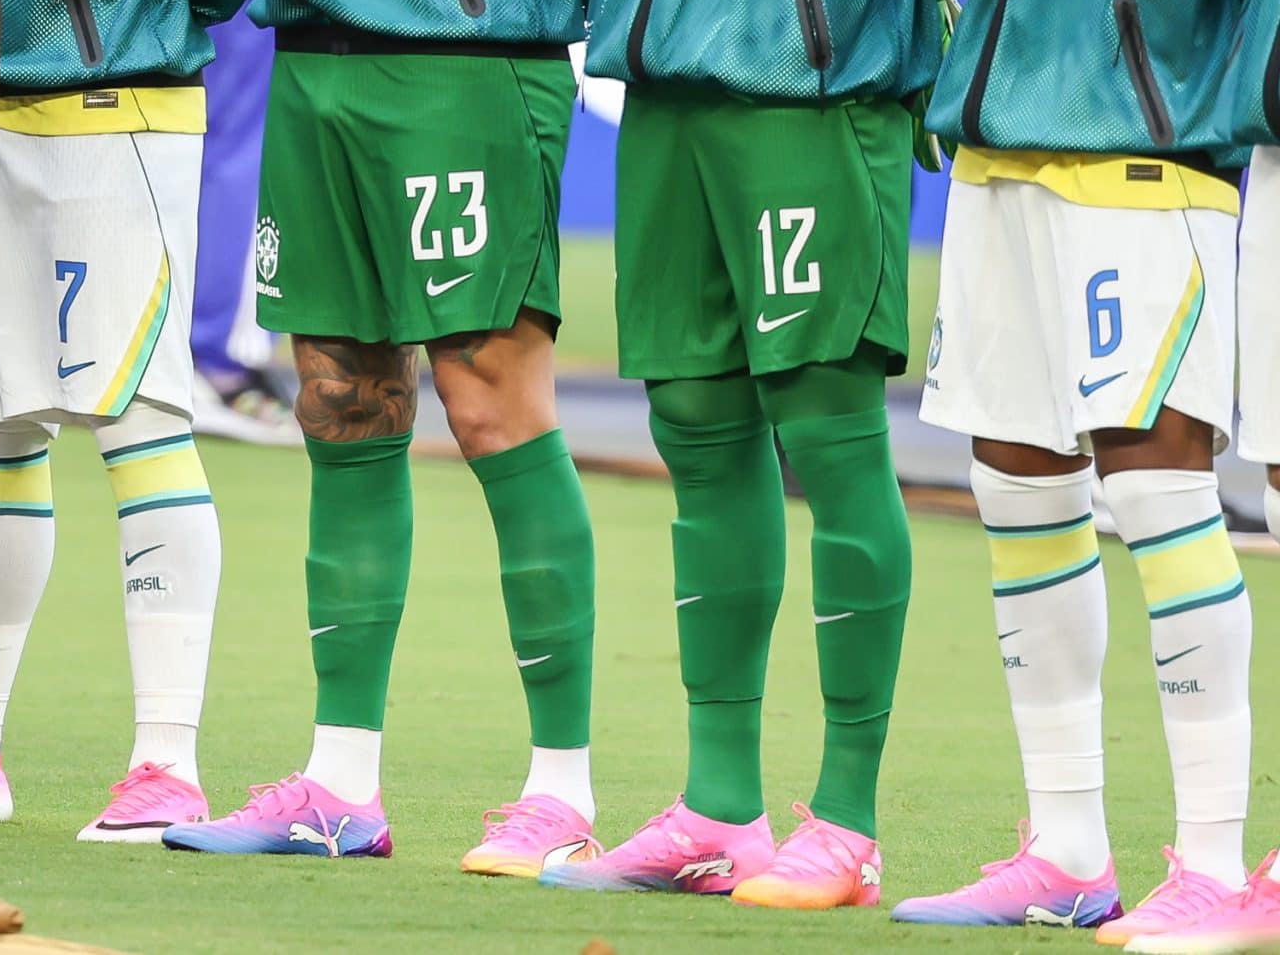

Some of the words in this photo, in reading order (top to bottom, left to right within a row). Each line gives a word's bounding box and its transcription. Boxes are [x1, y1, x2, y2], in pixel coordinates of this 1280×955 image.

[405, 170, 488, 261] 23
[757, 206, 820, 296] 12
[55, 260, 86, 343] 7
[1086, 269, 1122, 358] 6
[126, 576, 167, 595] BRASIL
